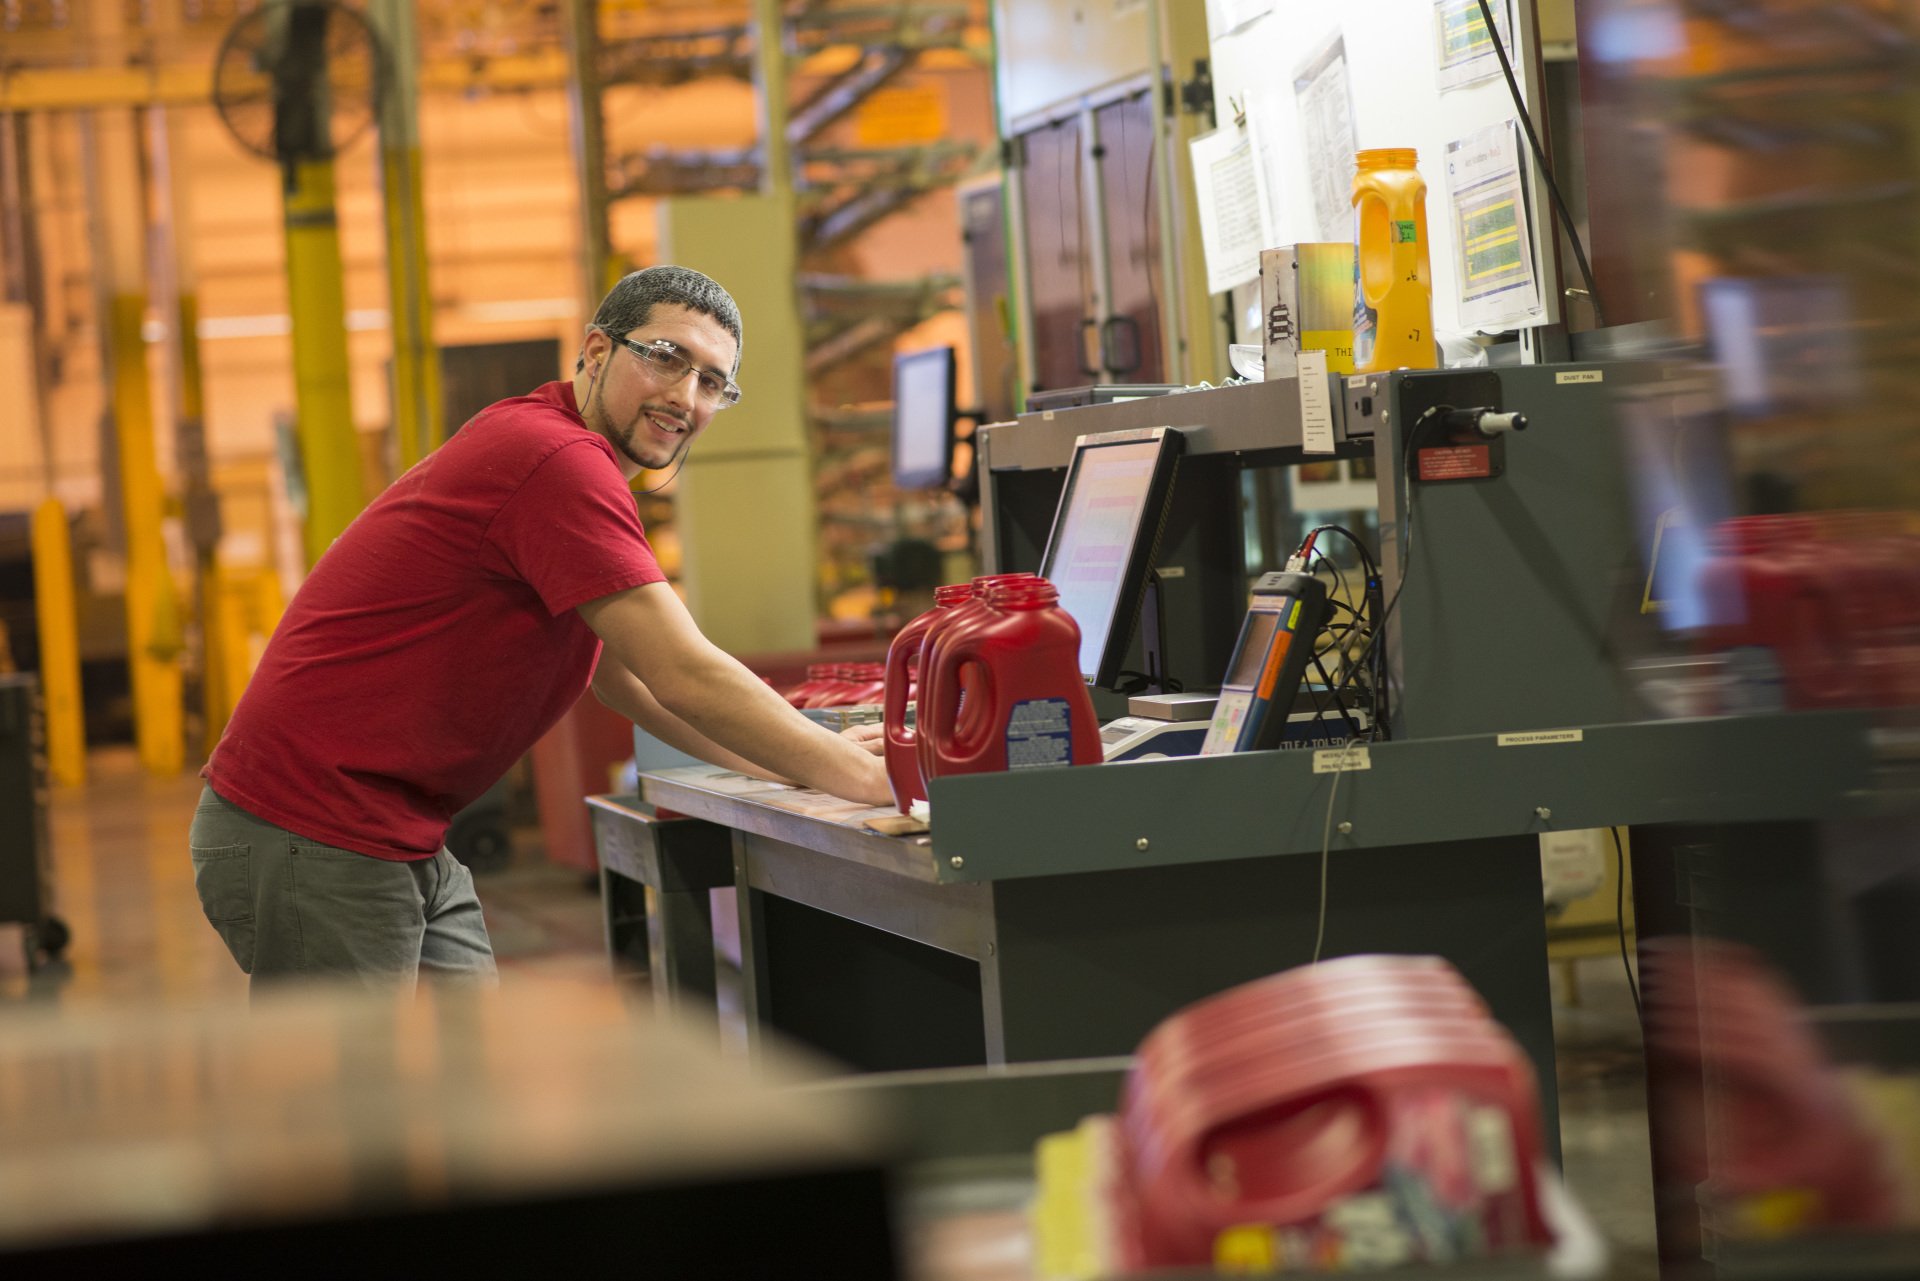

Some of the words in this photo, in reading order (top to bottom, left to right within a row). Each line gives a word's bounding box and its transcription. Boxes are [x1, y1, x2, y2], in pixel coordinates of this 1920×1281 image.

[1335, 347, 1353, 357] THI
[1563, 374, 1580, 382] DUST
[1582, 373, 1595, 381] PAN
[1505, 735, 1534, 743] PROCESS
[1535, 733, 1575, 742] PARAMETERS
